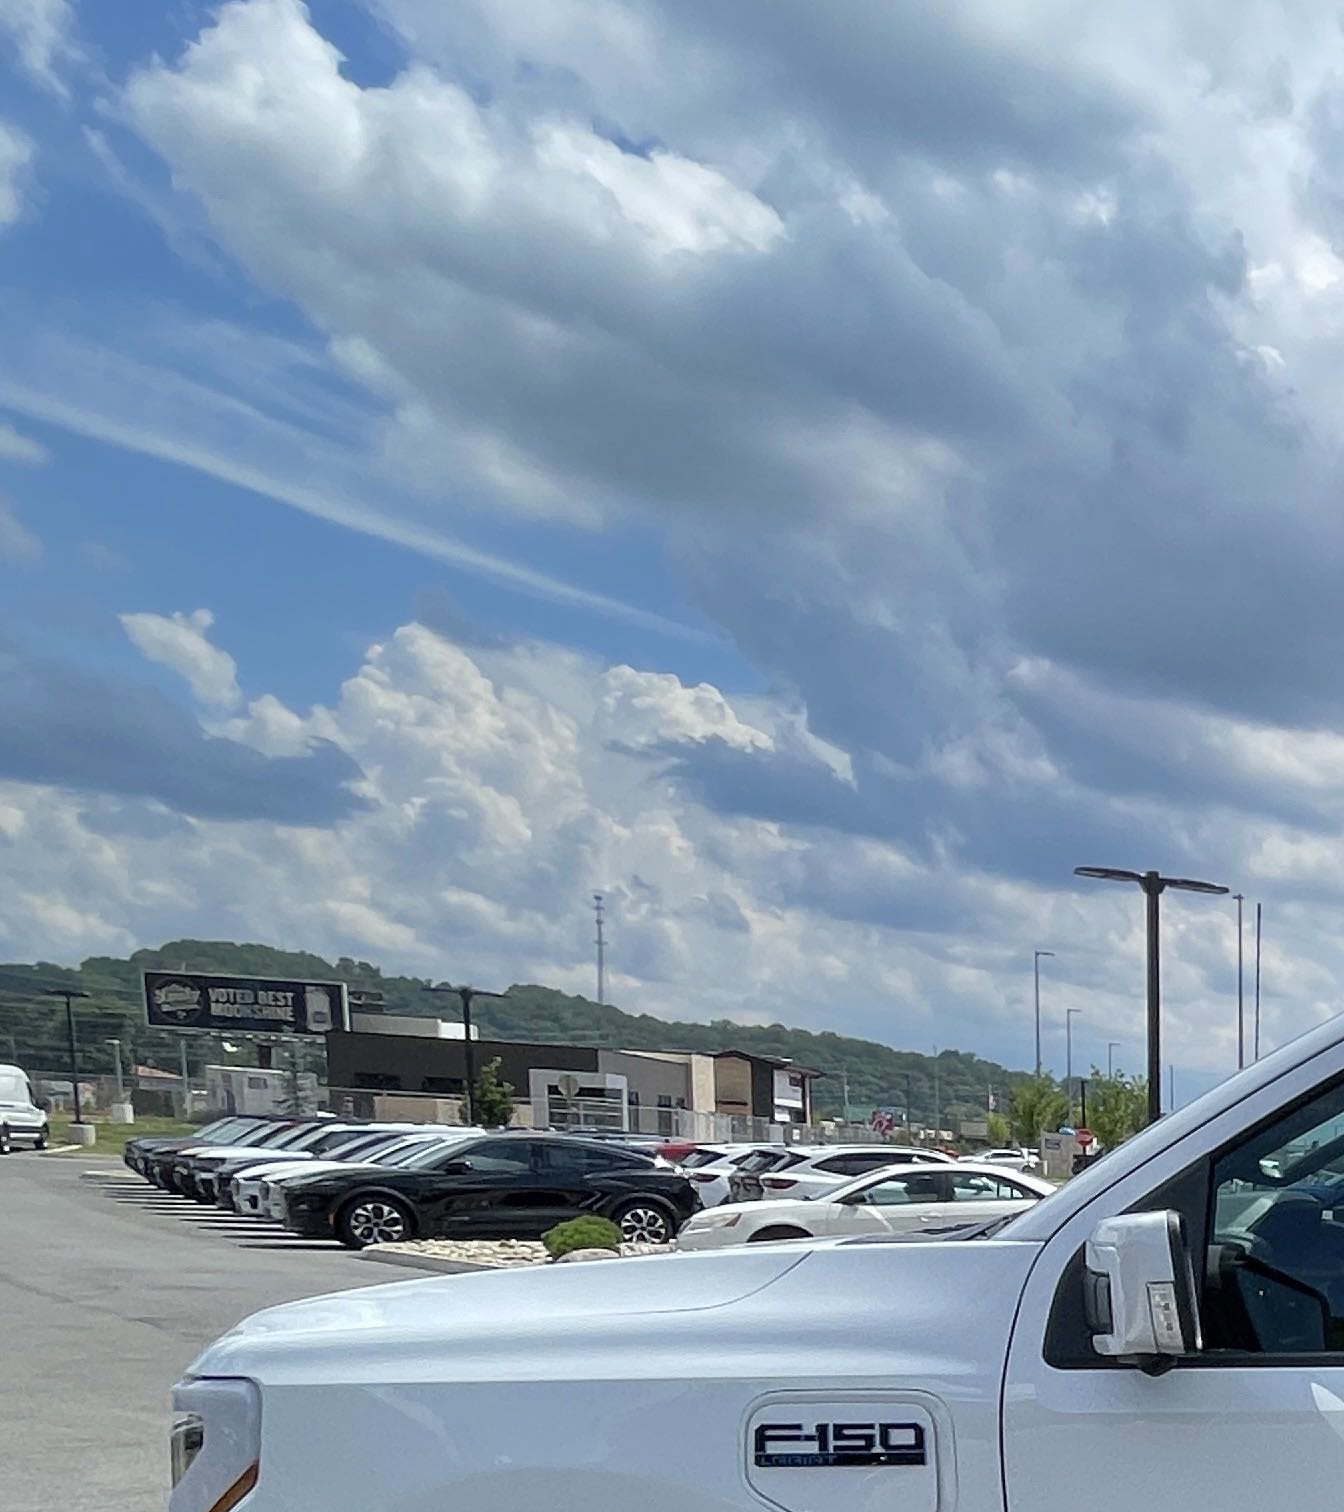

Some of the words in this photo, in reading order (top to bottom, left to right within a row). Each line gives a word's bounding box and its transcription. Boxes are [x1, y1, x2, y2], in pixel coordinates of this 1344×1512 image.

[208, 987, 254, 1003] VOTED
[257, 990, 295, 1006] BEST
[754, 1422, 926, 1453] F-150
